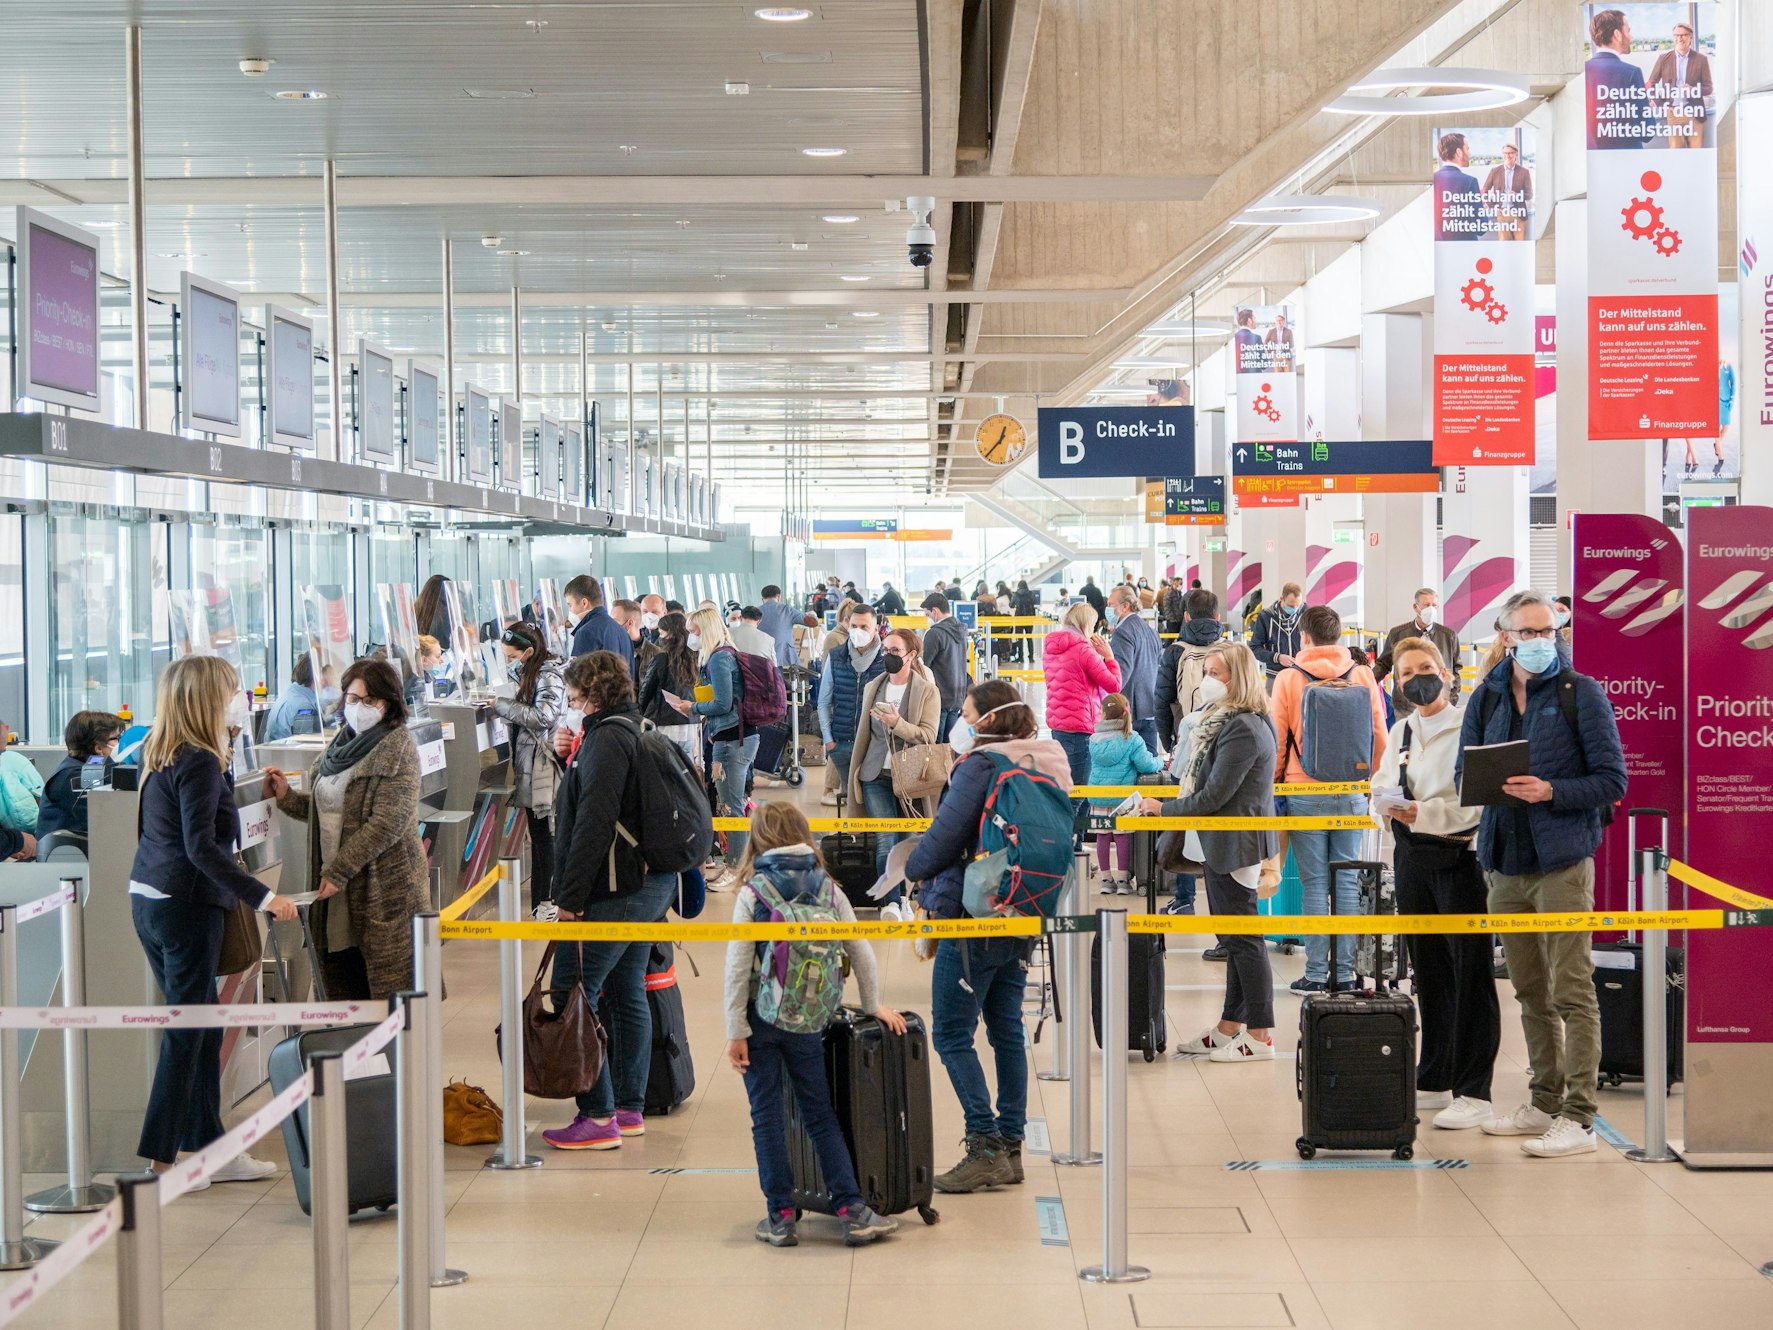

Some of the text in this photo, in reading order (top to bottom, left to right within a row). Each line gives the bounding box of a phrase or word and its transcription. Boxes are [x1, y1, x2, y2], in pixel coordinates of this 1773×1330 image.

[1597, 83, 1701, 100] Deutschland
[1596, 102, 1704, 119] zählt auf den
[1597, 121, 1698, 138] Mittelstand.
[1442, 190, 1524, 203] Deutschland
[1442, 205, 1526, 217] zählt auf den
[1442, 219, 1521, 232] Mittelstand.
[1599, 307, 1681, 318] Der Mittelstand
[1600, 321, 1706, 332] kann auf uns zählen.
[1240, 342, 1290, 351] Deutschland
[1624, 340, 1651, 348] Sparkasse
[1240, 351, 1291, 360] zählt auf den
[1241, 360, 1288, 369] Mittelstand.
[1442, 364, 1507, 372] Der Mittelstand
[1654, 421, 1707, 430] Finanzgruppe
[51, 420, 68, 451] B01
[1059, 420, 1176, 465] B Check-in
[1277, 448, 1299, 458] Bahn
[1484, 451, 1526, 459] Finanzgruppe
[210, 447, 222, 471] B02
[1277, 460, 1303, 471] Trains
[1583, 546, 1651, 561] Eurowings
[1597, 676, 1665, 699] riority-
[1615, 702, 1676, 721] eck-in
[1717, 785, 1737, 793] Circle
[1697, 795, 1759, 803] Senator/Frequent
[1697, 804, 1734, 814] Eurowings
[247, 820, 269, 838] Eurowings
[850, 821, 864, 829] Köln
[880, 822, 902, 830] Airport
[1126, 920, 1172, 929] onn Airport
[1491, 919, 1508, 928] Köln
[1533, 919, 1562, 928] Airport
[1618, 916, 1689, 926] Köln Bonn Airport
[441, 925, 492, 935] Bonn Airport
[810, 926, 881, 935] Köln Bonn Airport
[936, 925, 953, 933] Köln
[977, 923, 1007, 932] Airport
[122, 1014, 170, 1024] Eurowings
[301, 1011, 348, 1021] Eurowings
[1729, 1026, 1751, 1034] Group
